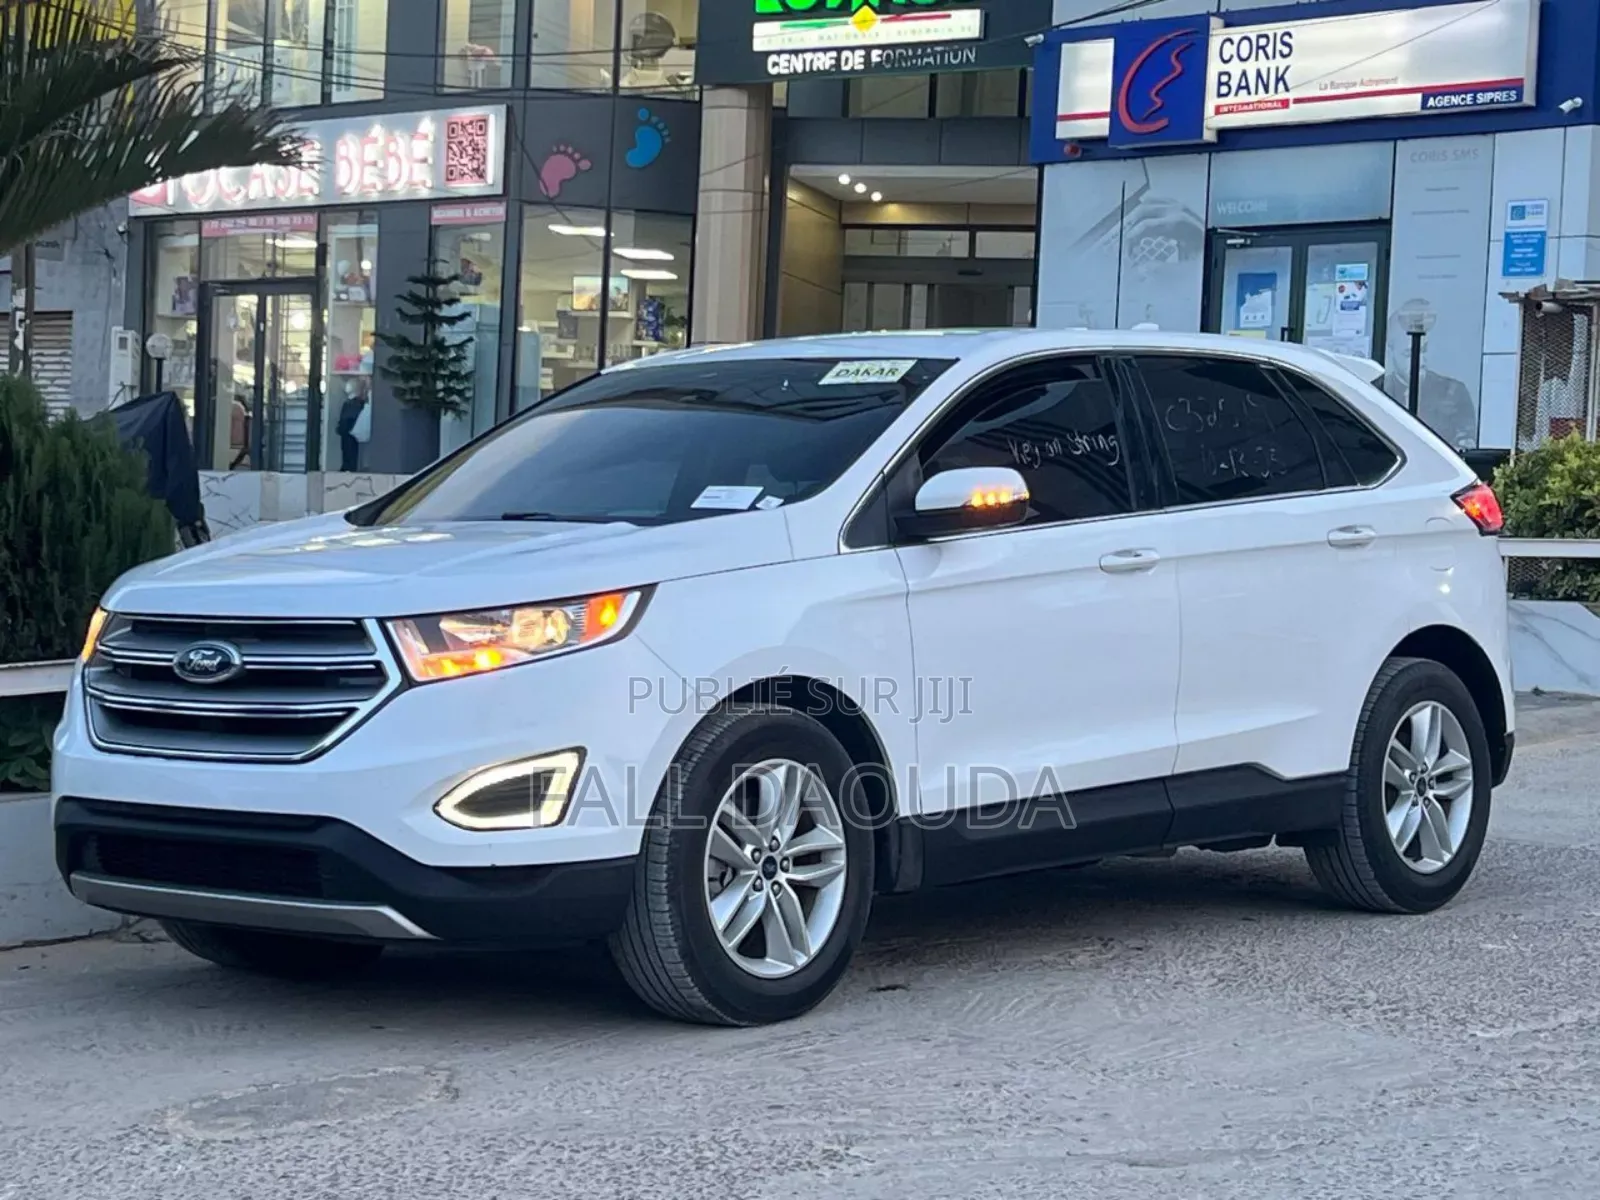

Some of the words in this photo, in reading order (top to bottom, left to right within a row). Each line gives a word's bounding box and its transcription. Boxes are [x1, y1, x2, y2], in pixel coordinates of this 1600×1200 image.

[1219, 31, 1293, 64] CORIS
[766, 51, 836, 75] CENTRE
[841, 49, 865, 70] DE
[871, 46, 976, 69] FORMATION
[1216, 65, 1291, 98] BANK
[1319, 81, 1328, 91] La
[1219, 101, 1283, 113] INTERNATIONAL
[1426, 93, 1474, 108] AGENCE
[1475, 90, 1517, 105] SIPRES
[336, 116, 435, 196] BÉBÉ
[1452, 148, 1479, 161] SMS
[833, 367, 899, 378] DAKAR
[1007, 438, 1041, 469] Key
[185, 649, 222, 672] Ford
